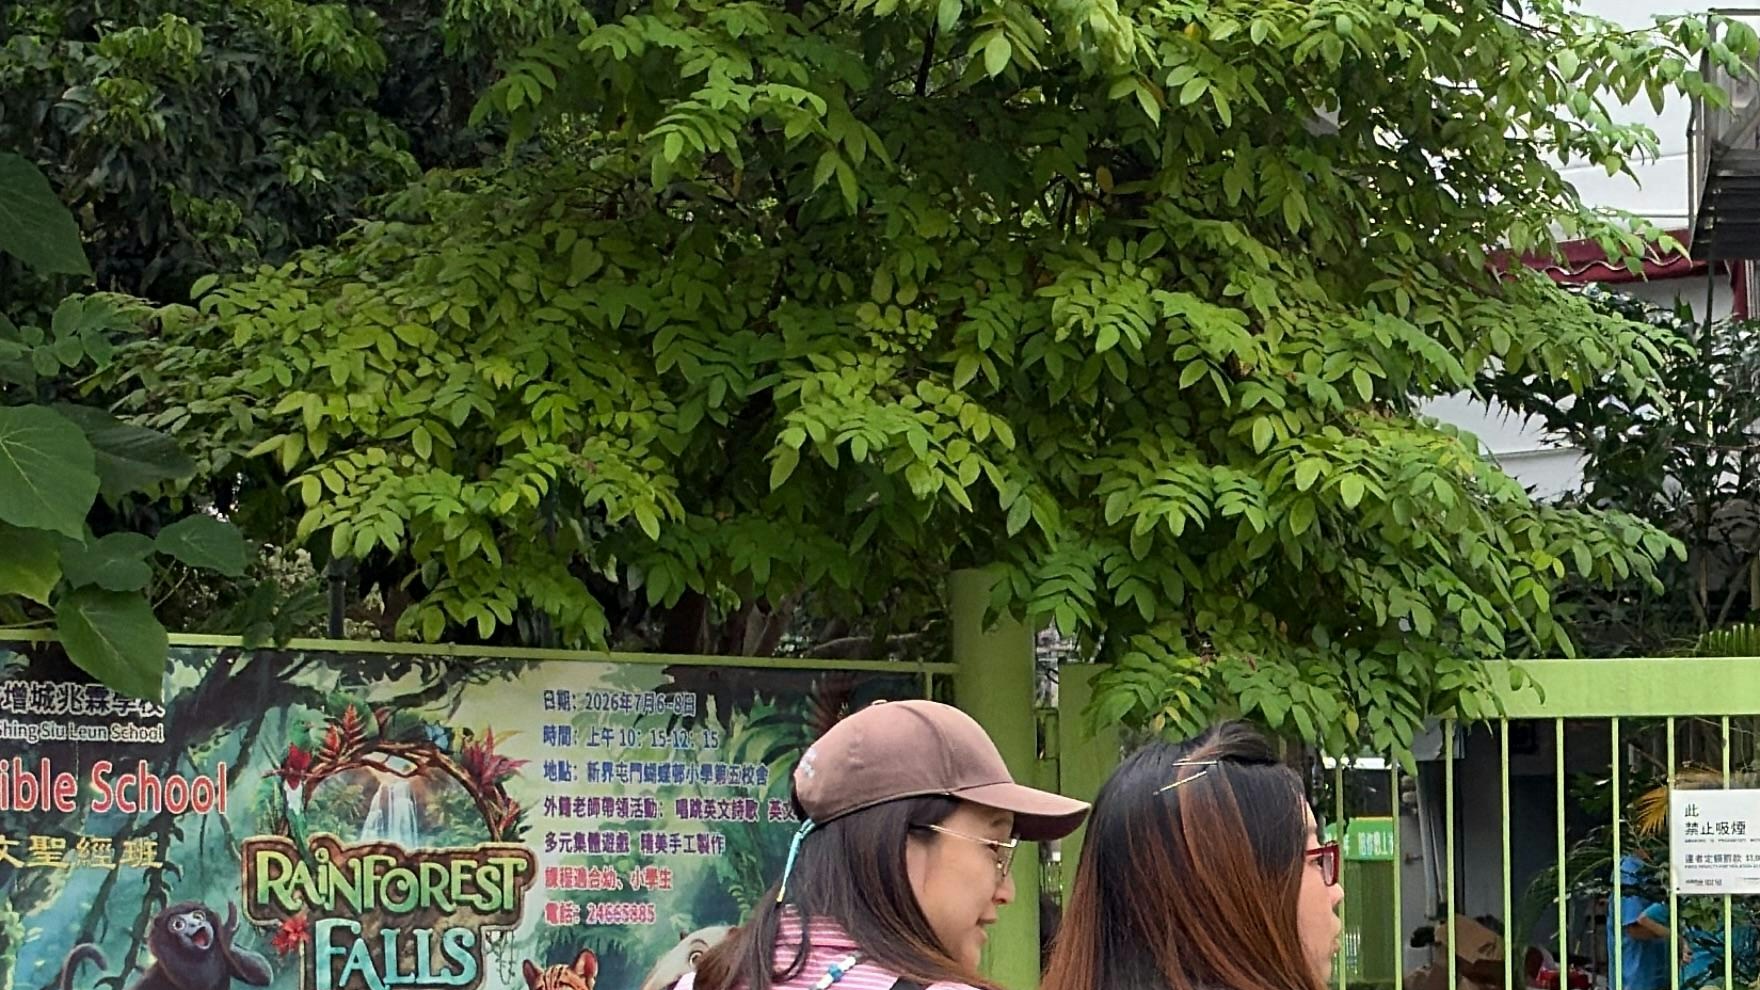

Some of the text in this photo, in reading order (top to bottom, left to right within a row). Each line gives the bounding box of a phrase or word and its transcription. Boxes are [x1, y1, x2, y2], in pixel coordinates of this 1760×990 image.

[0, 720, 39, 743] hing
[68, 722, 108, 741] Leun
[111, 722, 165, 743] School
[91, 760, 227, 814] School
[1685, 803, 1699, 817] 此
[1685, 821, 1745, 835] 禁止吸煙
